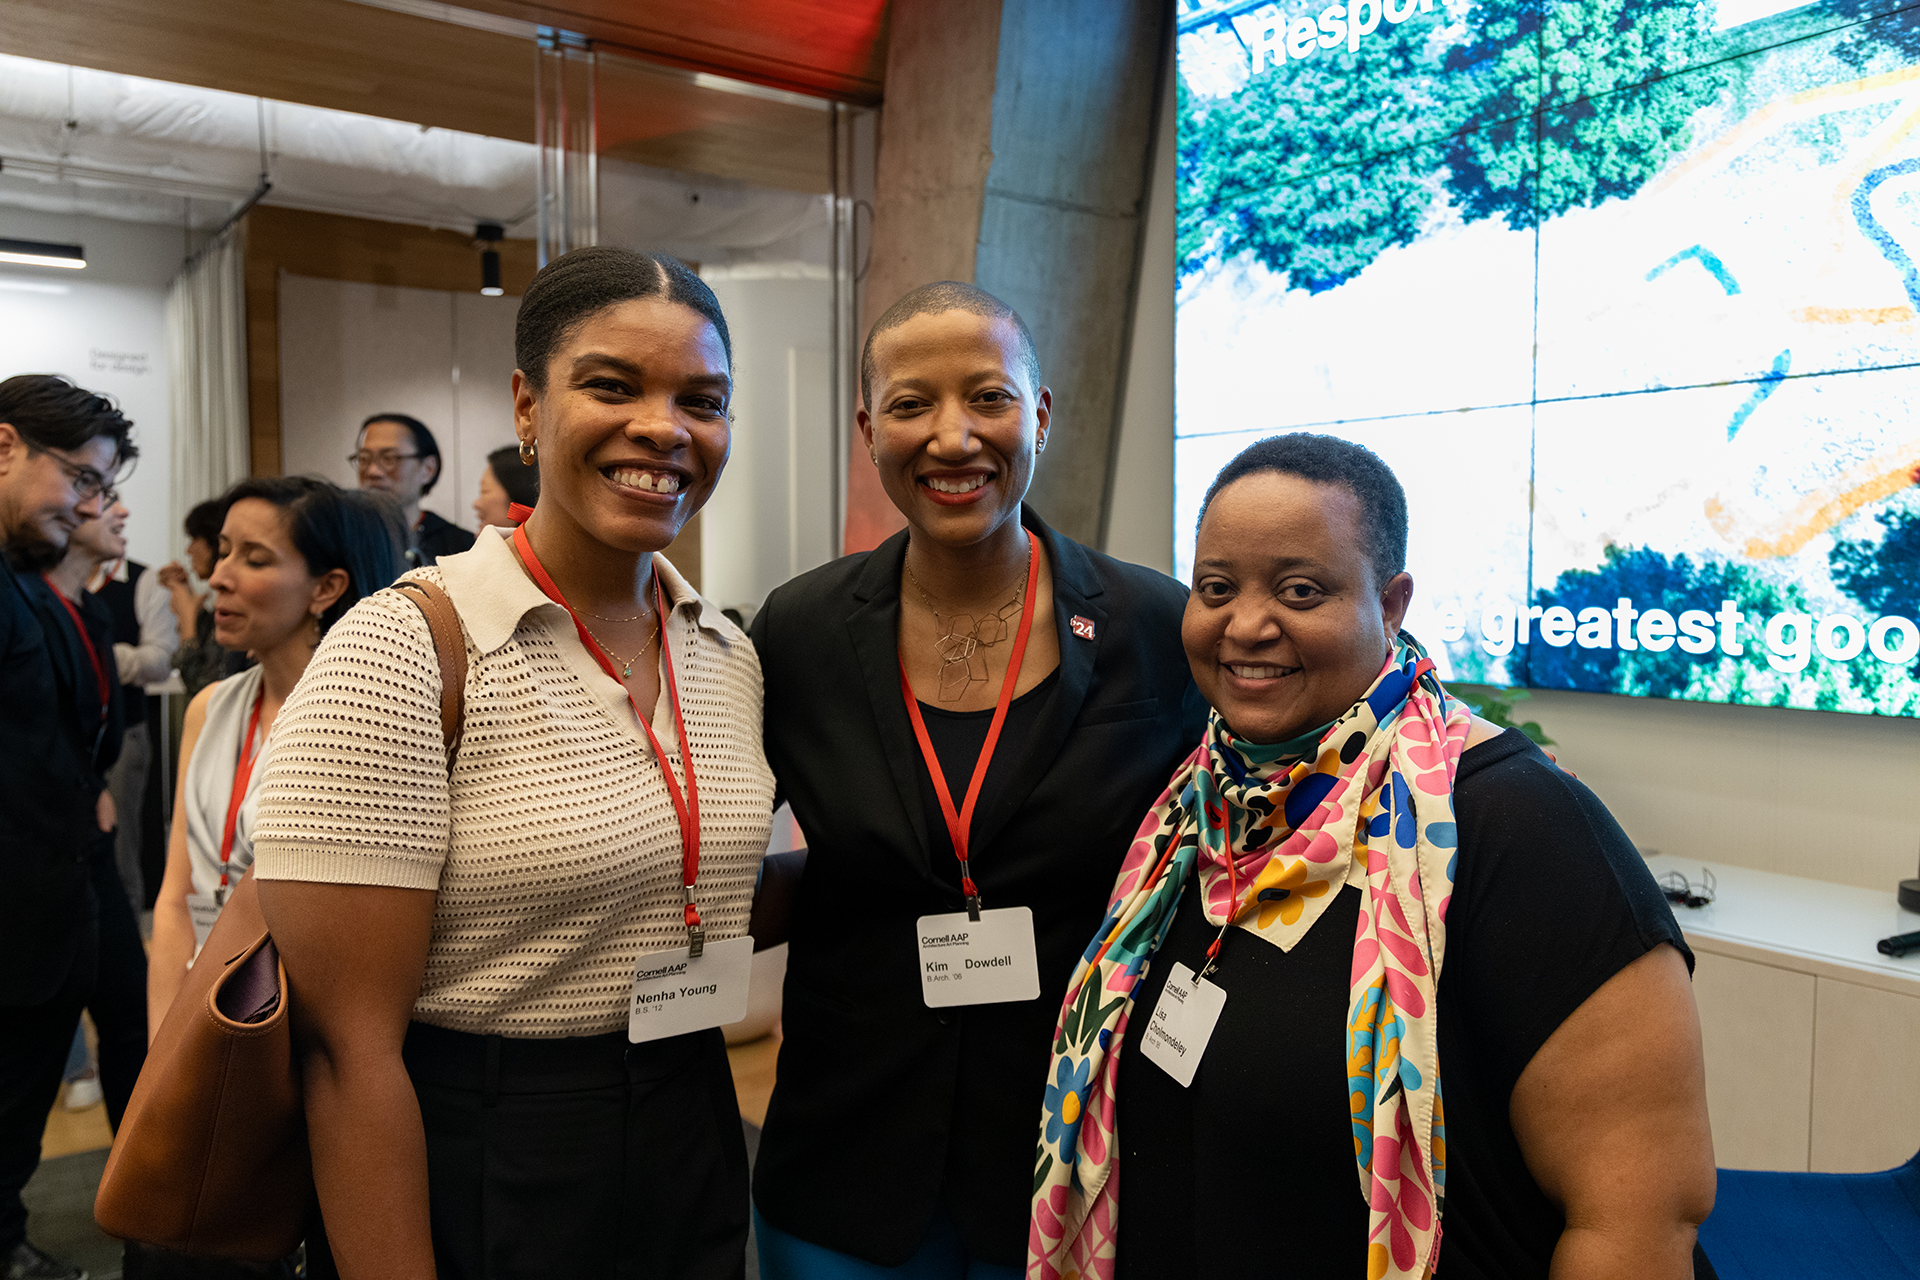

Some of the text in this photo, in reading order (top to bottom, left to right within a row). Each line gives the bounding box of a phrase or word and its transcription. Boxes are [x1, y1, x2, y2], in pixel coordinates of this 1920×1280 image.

[1250, 0, 1450, 75] Respo
[1072, 620, 1093, 638] '24
[1481, 597, 1744, 656] greatest
[922, 933, 968, 944] Cornell AAP
[637, 963, 687, 978] Cornell AAP
[926, 956, 1011, 972] Kim Dowdell
[636, 984, 717, 1004] Nenha Young
[1155, 1006, 1167, 1021] Lisa
[1150, 1020, 1187, 1057] Cholmondeley
